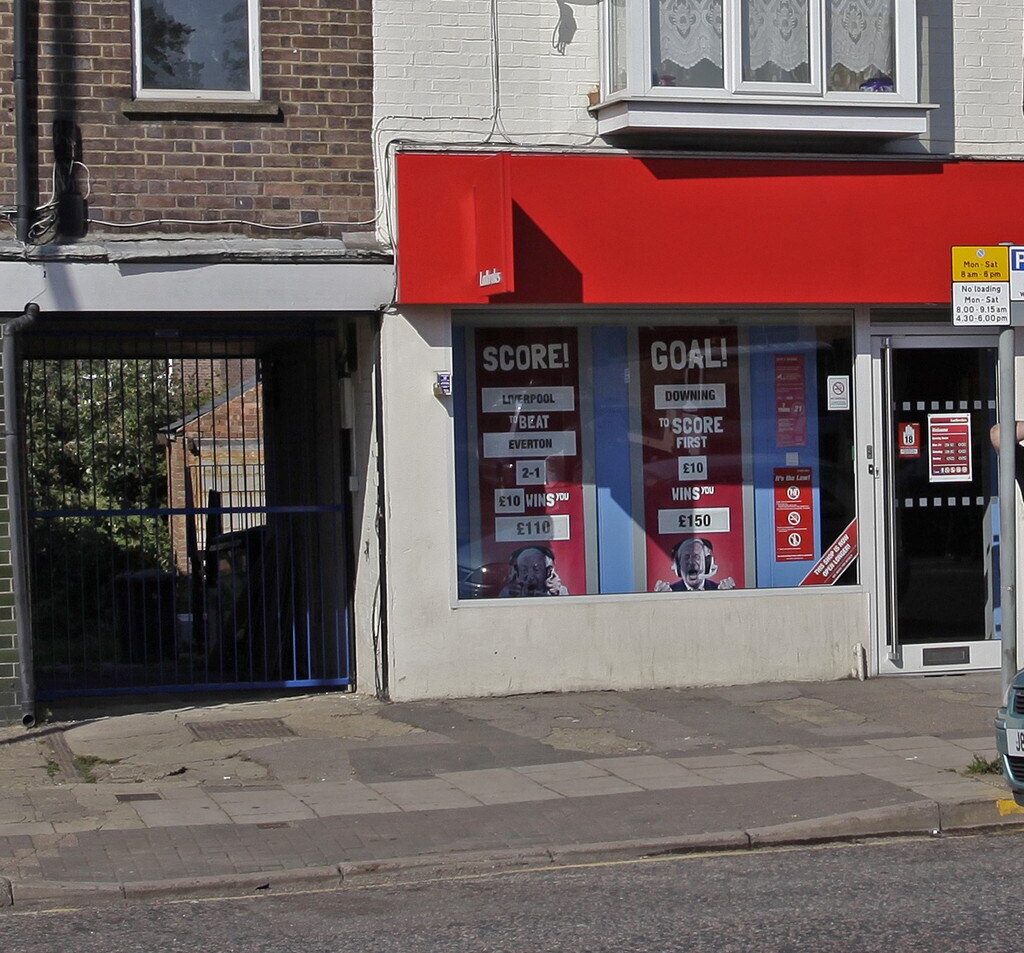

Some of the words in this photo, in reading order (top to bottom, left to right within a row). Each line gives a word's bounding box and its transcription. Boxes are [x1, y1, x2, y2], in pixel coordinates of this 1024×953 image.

[974, 285, 1001, 294] loading
[482, 343, 570, 372] SCORE!
[650, 337, 728, 371] GOAL!
[502, 393, 555, 405] LIVERPOOL
[665, 389, 716, 402] DOWNING
[509, 416, 518, 424] TO
[519, 414, 549, 429] BEAT
[659, 417, 670, 428] TO
[672, 416, 724, 434] SCORE
[508, 438, 553, 450] EVERTON
[676, 435, 707, 449] FIRST
[905, 435, 914, 444] 18
[521, 467, 540, 479] 2-1
[683, 462, 703, 474] £10
[499, 494, 521, 507] £10
[525, 493, 555, 508] WINS
[671, 486, 700, 501] WINS
[678, 513, 711, 528] £150
[516, 521, 551, 536] £110
